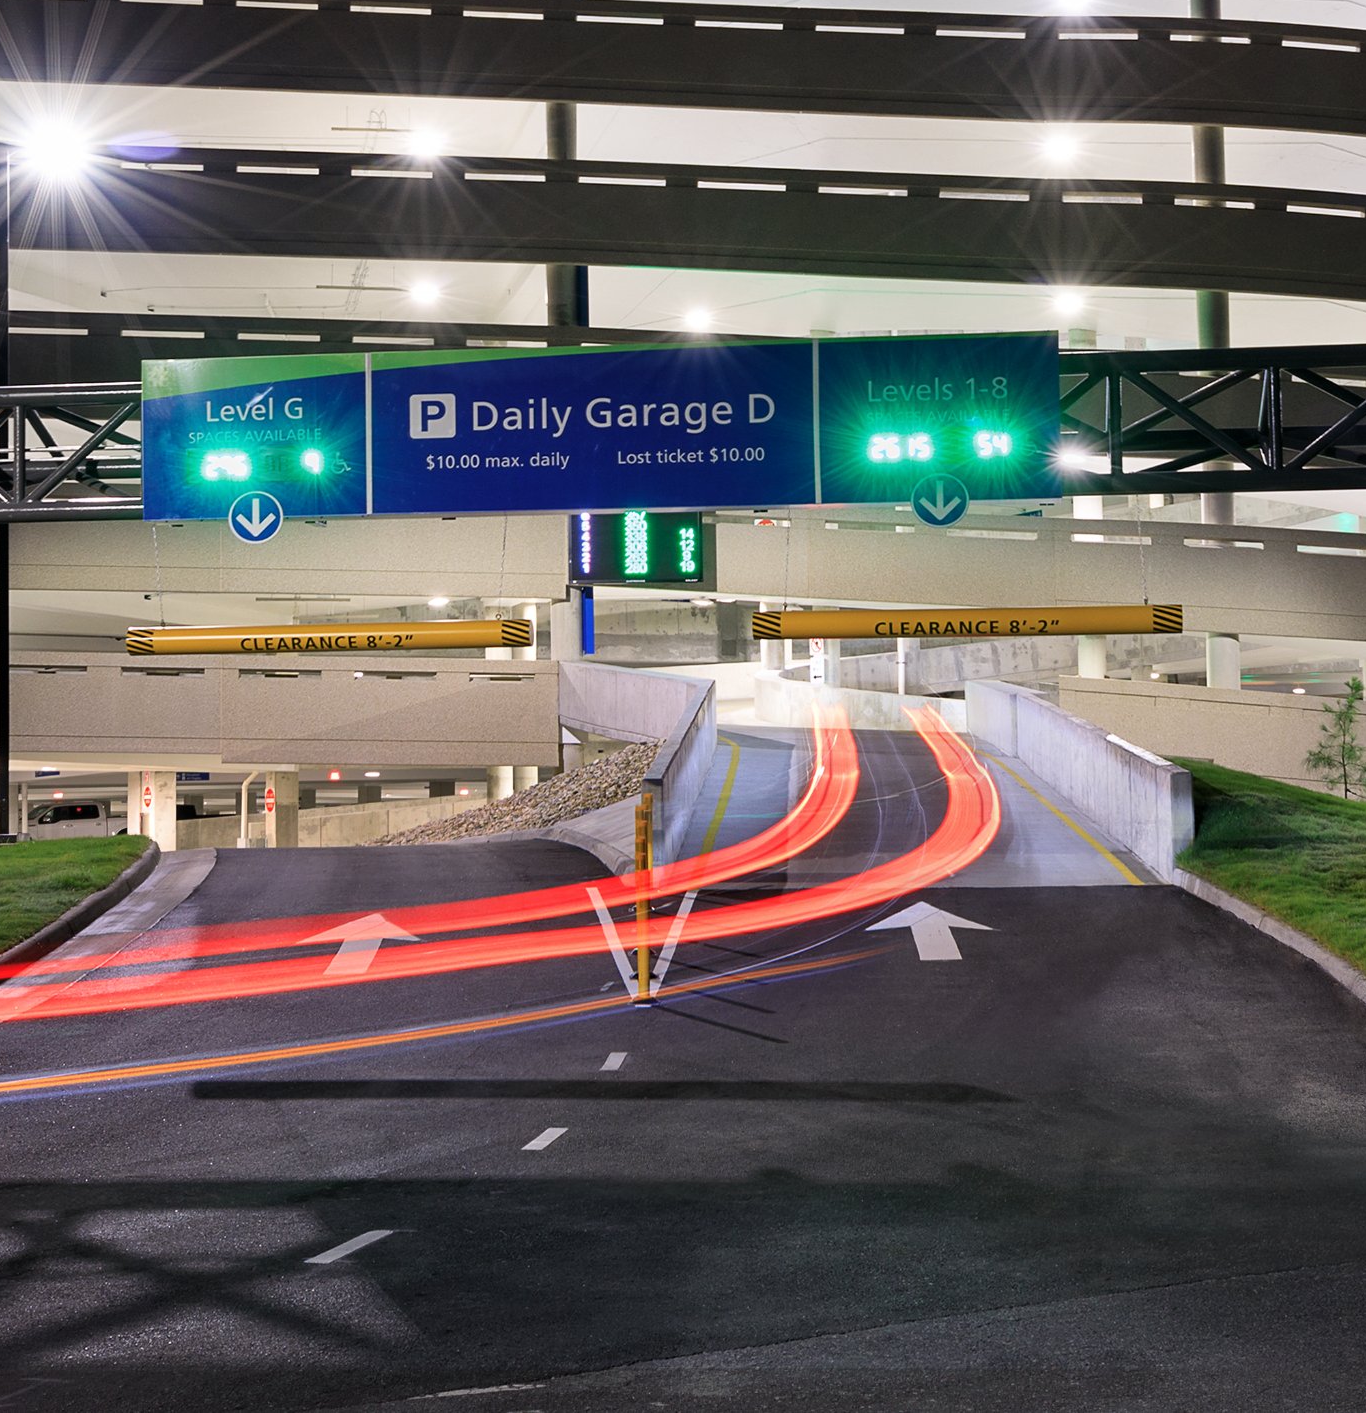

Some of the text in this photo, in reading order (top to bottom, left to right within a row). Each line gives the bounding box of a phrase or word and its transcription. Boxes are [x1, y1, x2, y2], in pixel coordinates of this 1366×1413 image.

[867, 376, 1008, 402] Levels 1-8
[206, 397, 303, 422] Level G
[472, 397, 572, 438] Daily
[585, 397, 733, 434] Garage
[747, 393, 776, 424] D
[188, 428, 322, 444] SPACES AVAILABLE
[975, 432, 1009, 458] 54
[426, 451, 570, 470] $10.00 max. daily
[617, 446, 765, 464] Lost ticket $10.00
[679, 528, 695, 539] 14
[679, 539, 695, 551] 12
[874, 620, 999, 635] CLEARANCE
[240, 636, 358, 651] CLEARANCE
